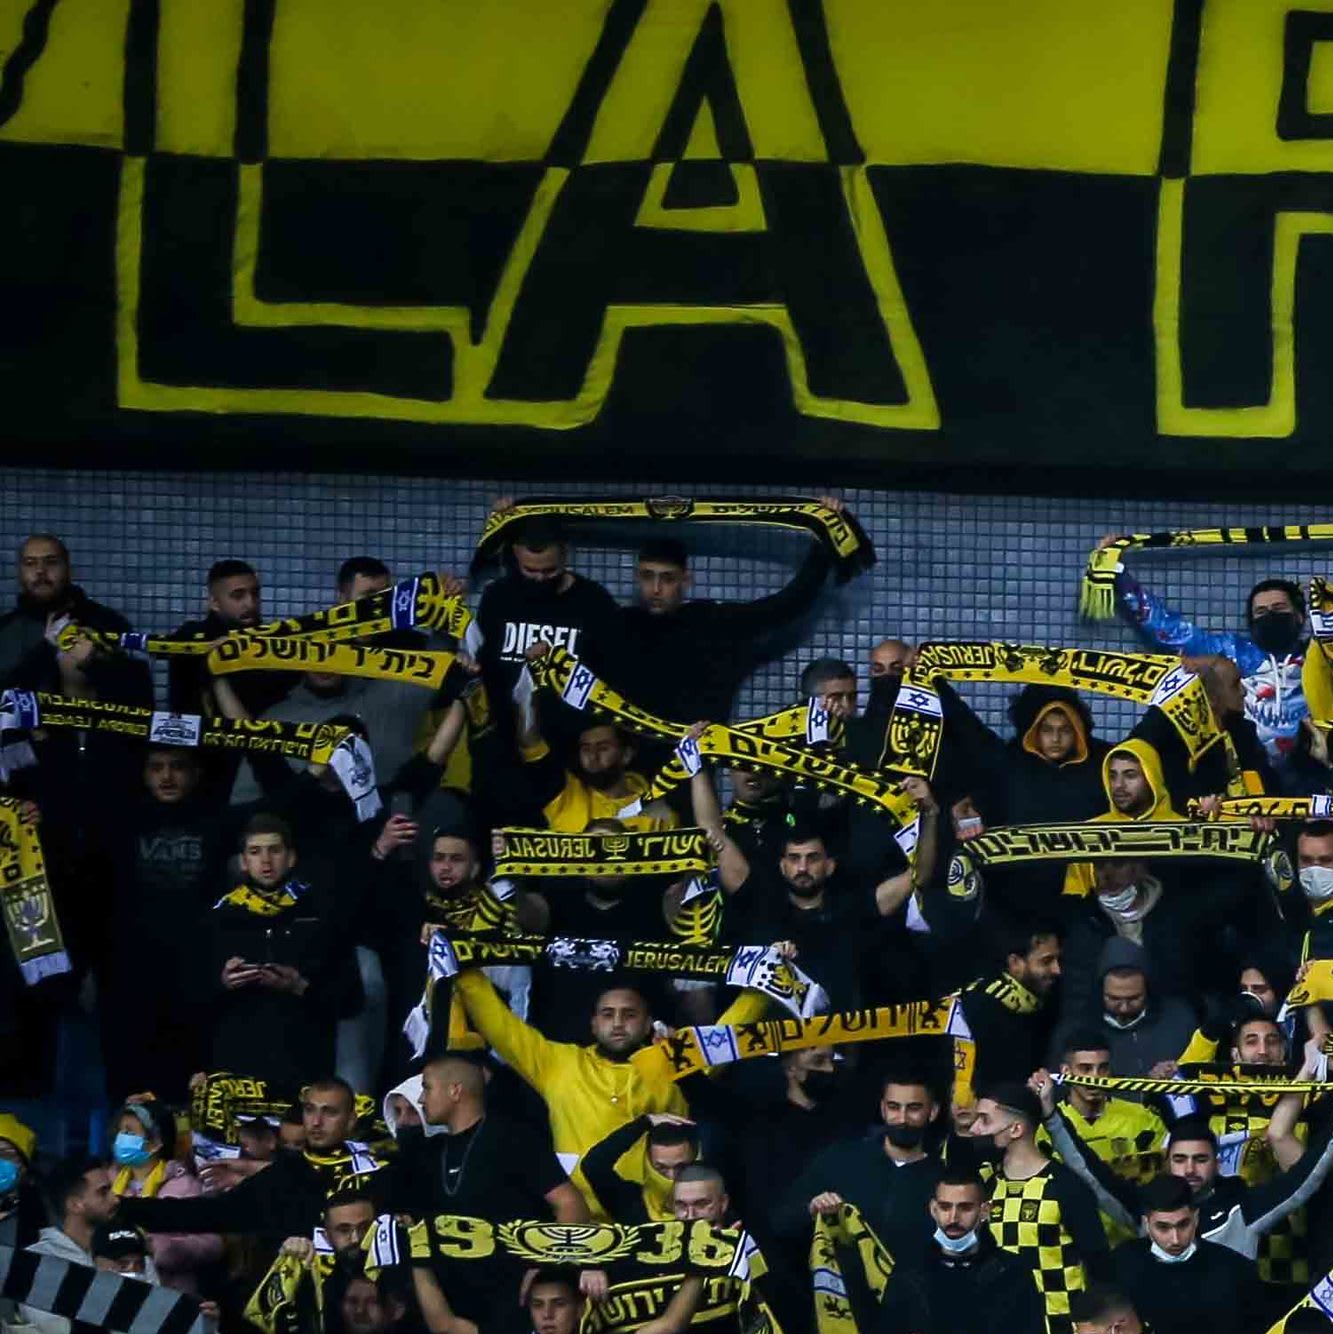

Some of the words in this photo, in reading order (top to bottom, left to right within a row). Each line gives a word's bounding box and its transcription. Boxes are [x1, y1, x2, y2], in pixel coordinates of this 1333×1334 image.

[117, 0, 941, 430] LA
[219, 633, 337, 663] ירושלים
[625, 949, 730, 977] JERUSALEM
[408, 1215, 498, 1260] 19
[634, 1218, 740, 1268] 36
